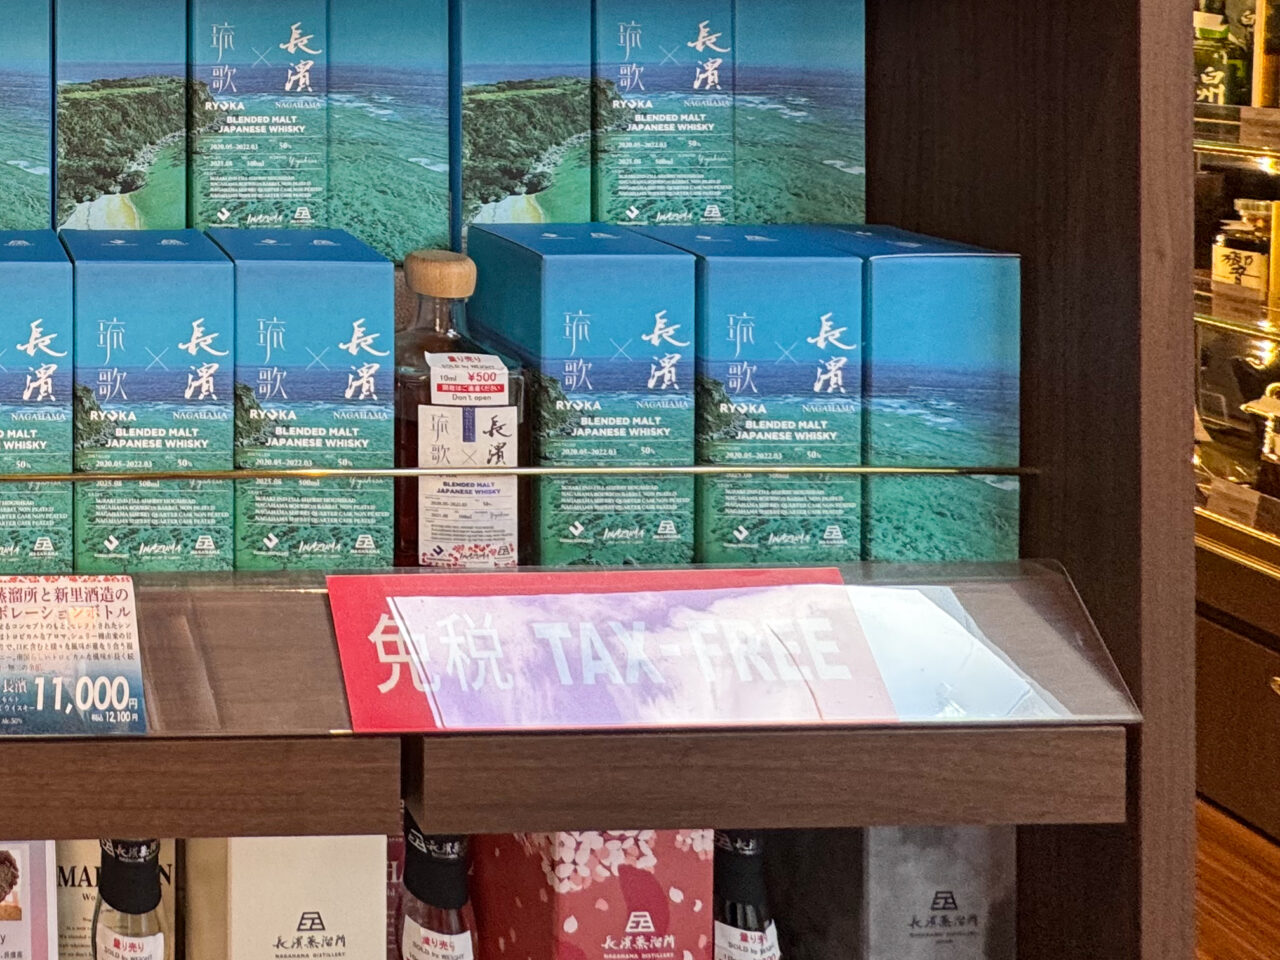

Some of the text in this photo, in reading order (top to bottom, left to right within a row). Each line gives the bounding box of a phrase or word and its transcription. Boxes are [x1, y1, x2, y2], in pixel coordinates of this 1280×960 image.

[279, 21, 322, 93] 長濱
[687, 19, 731, 91] 長濱
[16, 318, 67, 402] 長濱
[178, 317, 229, 401] 長濱
[339, 318, 390, 401] 長濱
[468, 372, 497, 382] ¥500
[641, 309, 691, 390] 長濱
[807, 312, 857, 394] 長濱
[105, 439, 209, 449] JAPANESE WHISKY
[115, 427, 199, 437] BLENDED MALT
[482, 414, 513, 465] 長濱
[735, 431, 837, 441] JAPANESE WHISKY
[745, 419, 828, 429] BLENDED MALT
[368, 612, 852, 694] 免税 TAX-FREE
[34, 675, 138, 714] 11,000円
